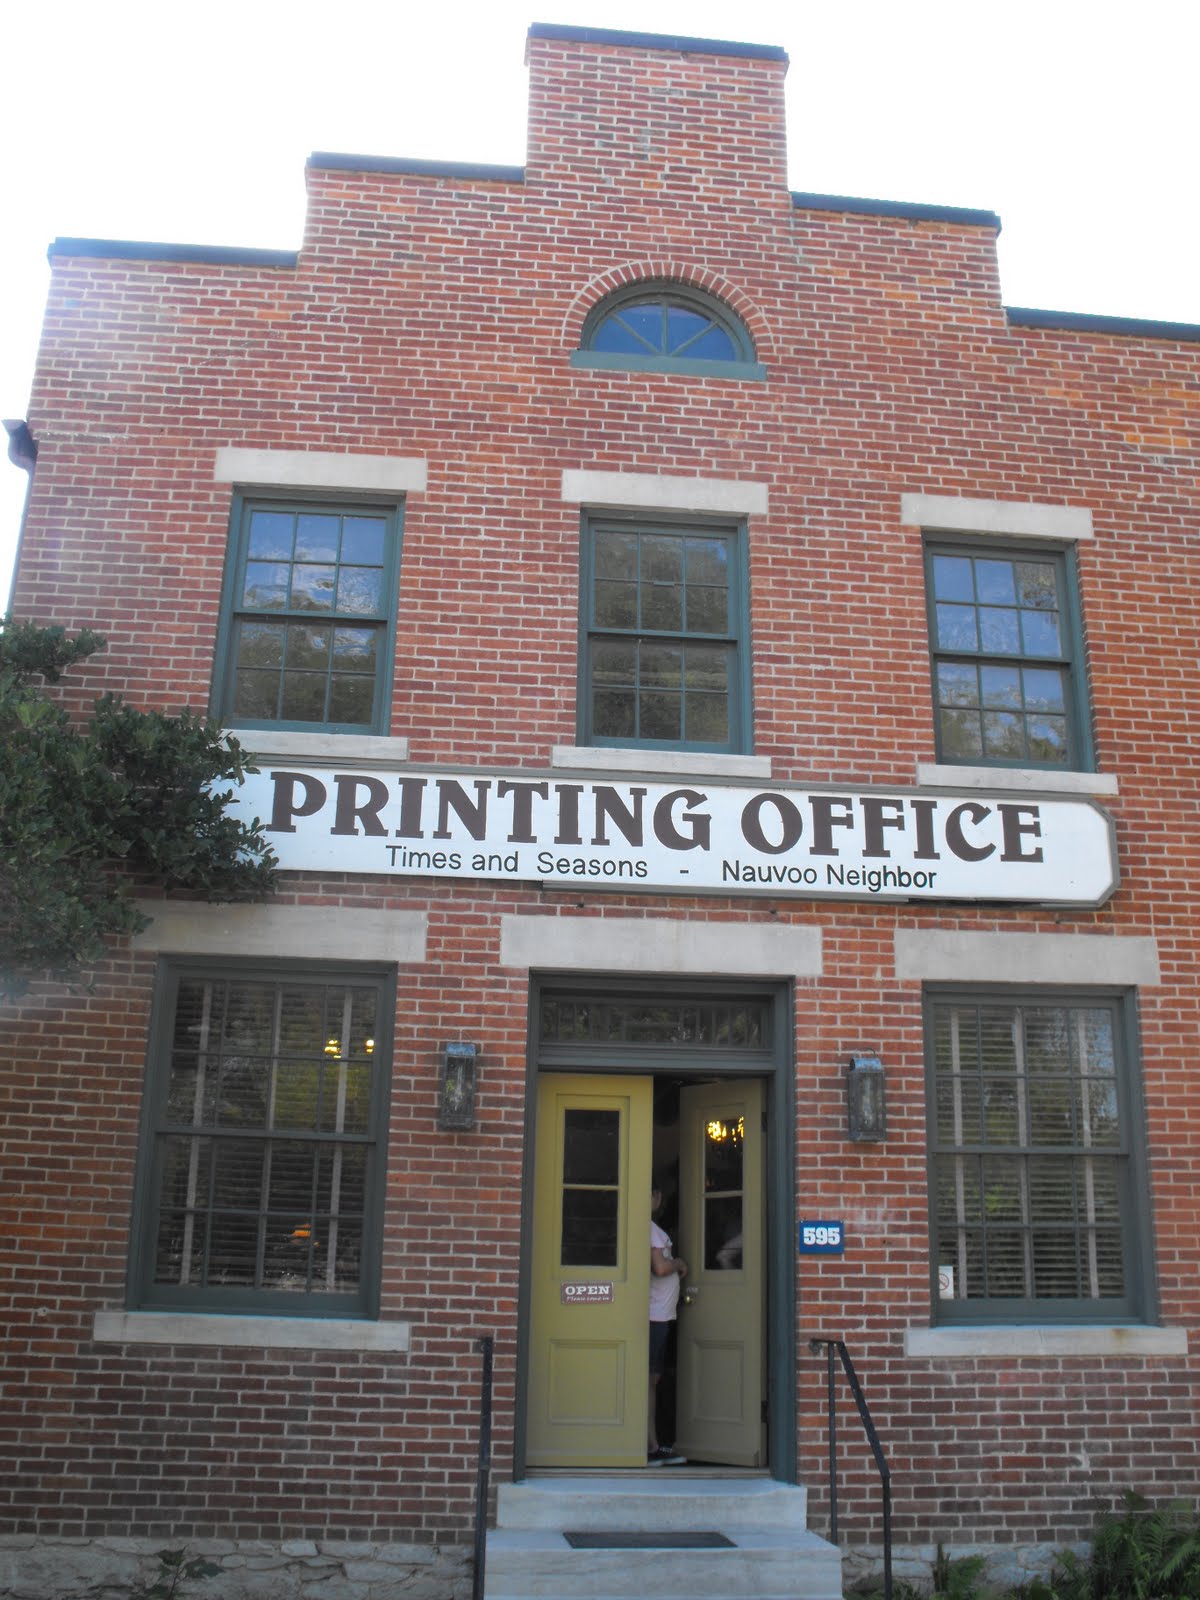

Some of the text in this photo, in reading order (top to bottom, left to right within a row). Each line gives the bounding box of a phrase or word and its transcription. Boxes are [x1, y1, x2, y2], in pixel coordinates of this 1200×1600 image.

[265, 771, 1044, 863] PRINTING OFFICE
[385, 844, 462, 871] Times
[471, 850, 519, 873] and
[536, 852, 648, 878] Seasons
[722, 860, 818, 885] Nauvoo
[826, 863, 938, 893] Neighbor
[803, 1227, 841, 1246] 595
[565, 1285, 610, 1296] OPEN
